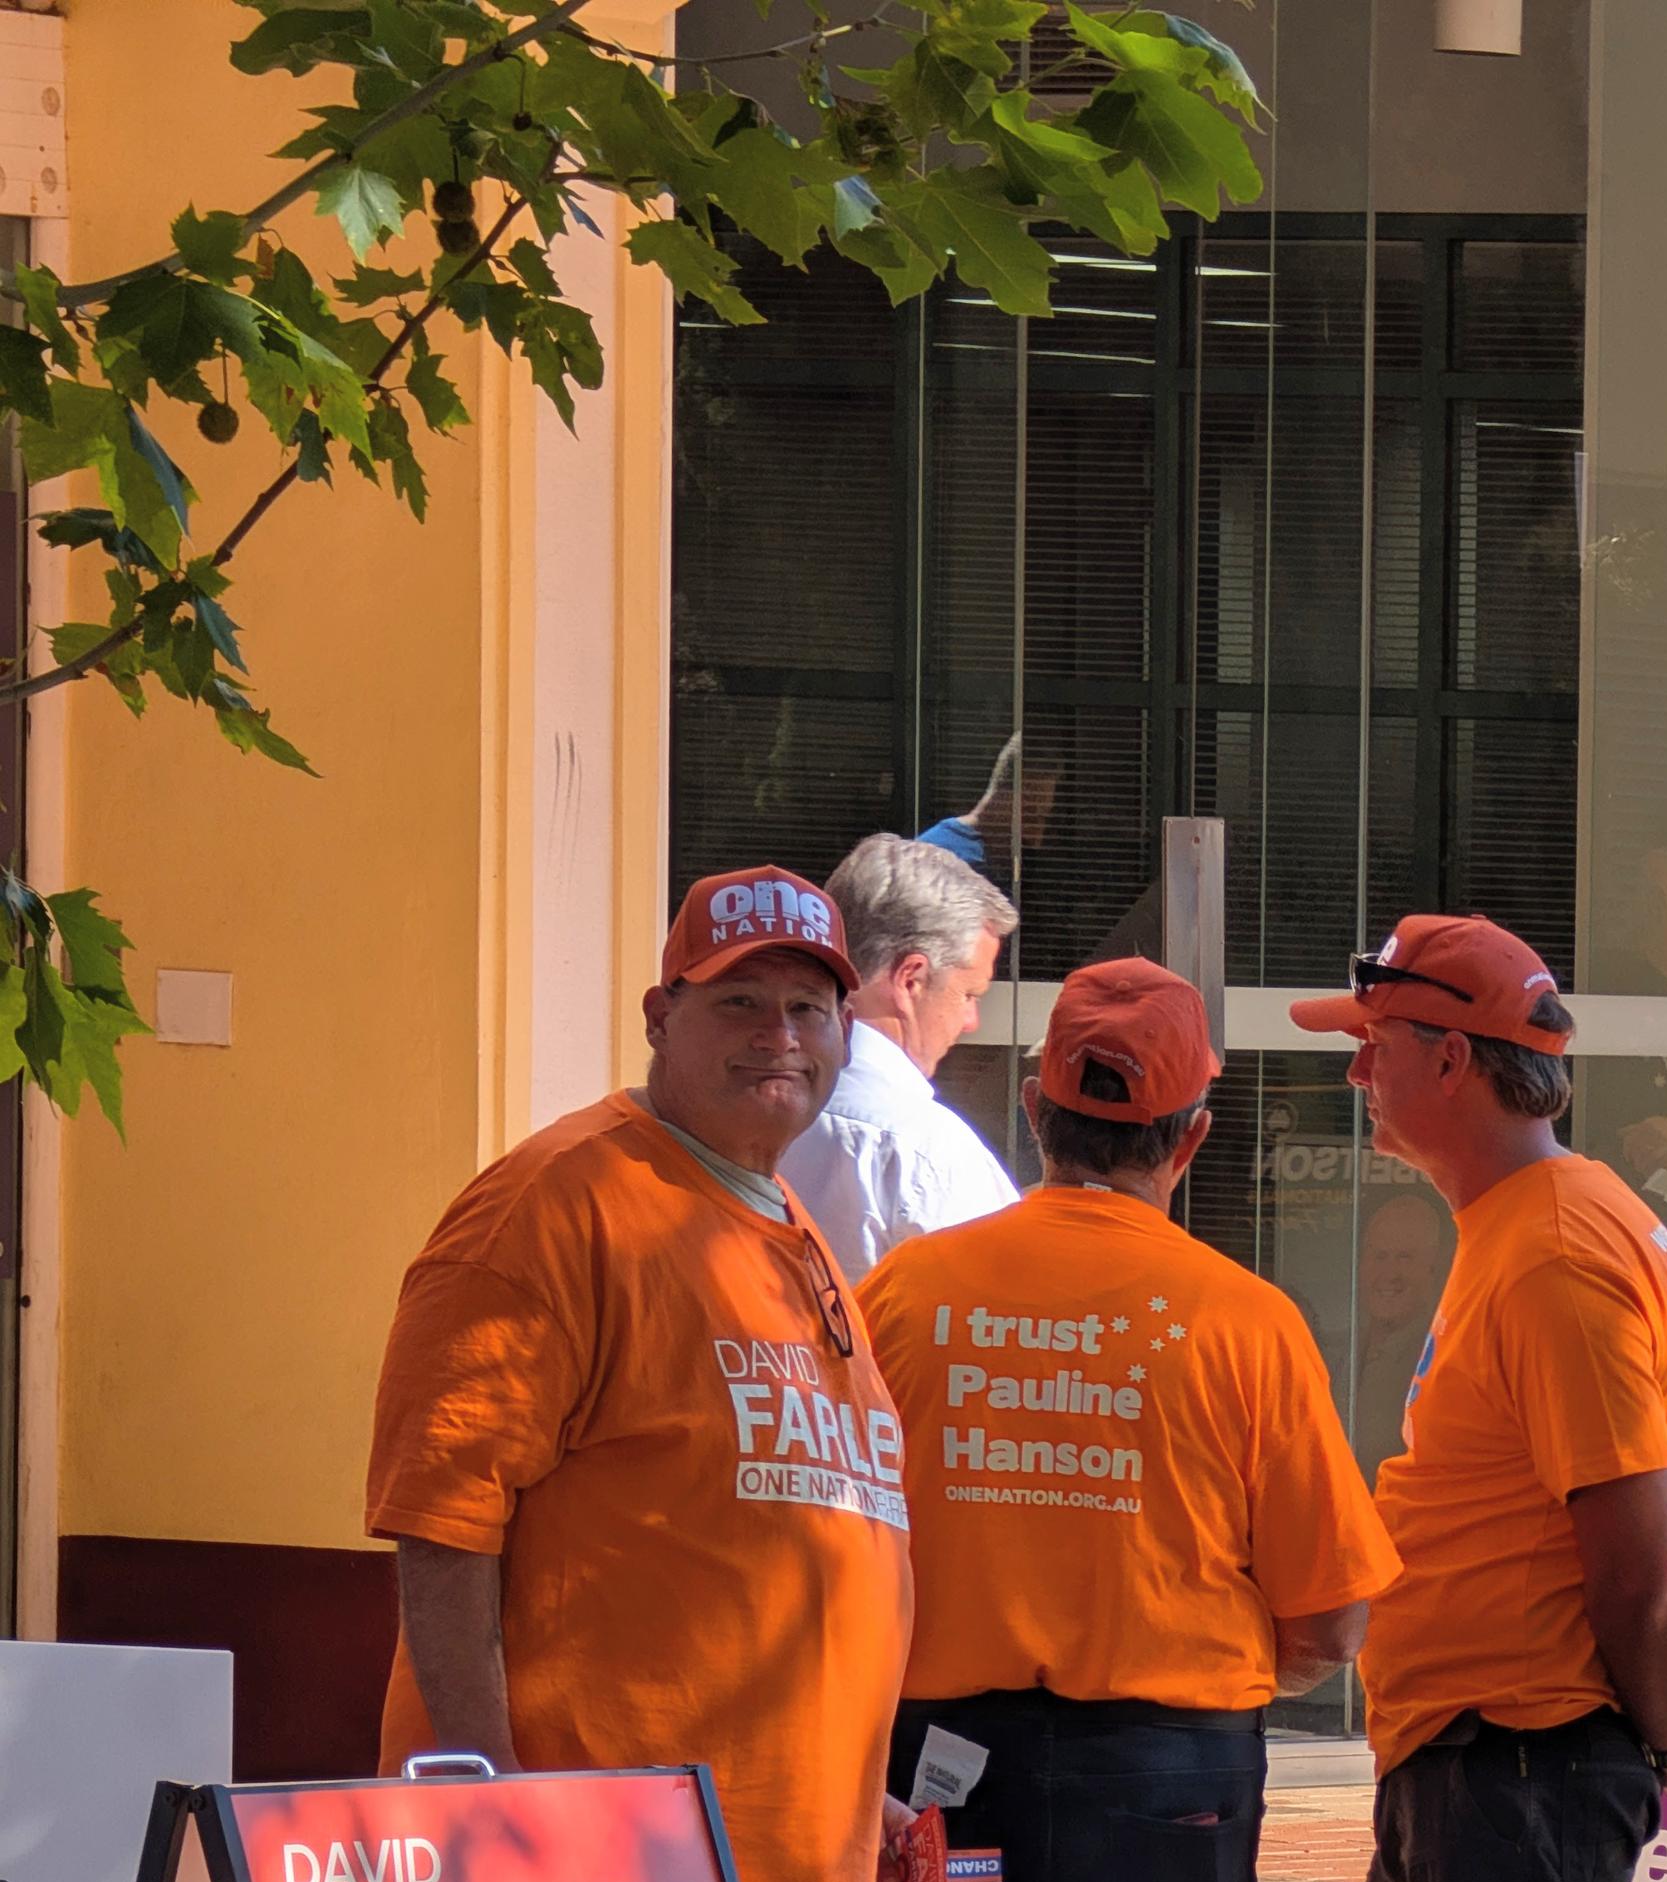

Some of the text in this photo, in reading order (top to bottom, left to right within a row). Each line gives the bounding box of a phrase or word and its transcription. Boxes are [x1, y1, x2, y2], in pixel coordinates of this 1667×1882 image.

[710, 881, 831, 937] one
[934, 1305, 1104, 1354] I trust
[714, 1340, 820, 1387] DAVID
[947, 1364, 1144, 1420] Pauline
[728, 1383, 905, 1485] FARLE
[943, 1426, 1144, 1482] Hanson
[741, 1468, 877, 1513] ONE NATION
[945, 1486, 1143, 1515] ONENATION.ORG.AU
[945, 1860, 999, 1875] CHAN
